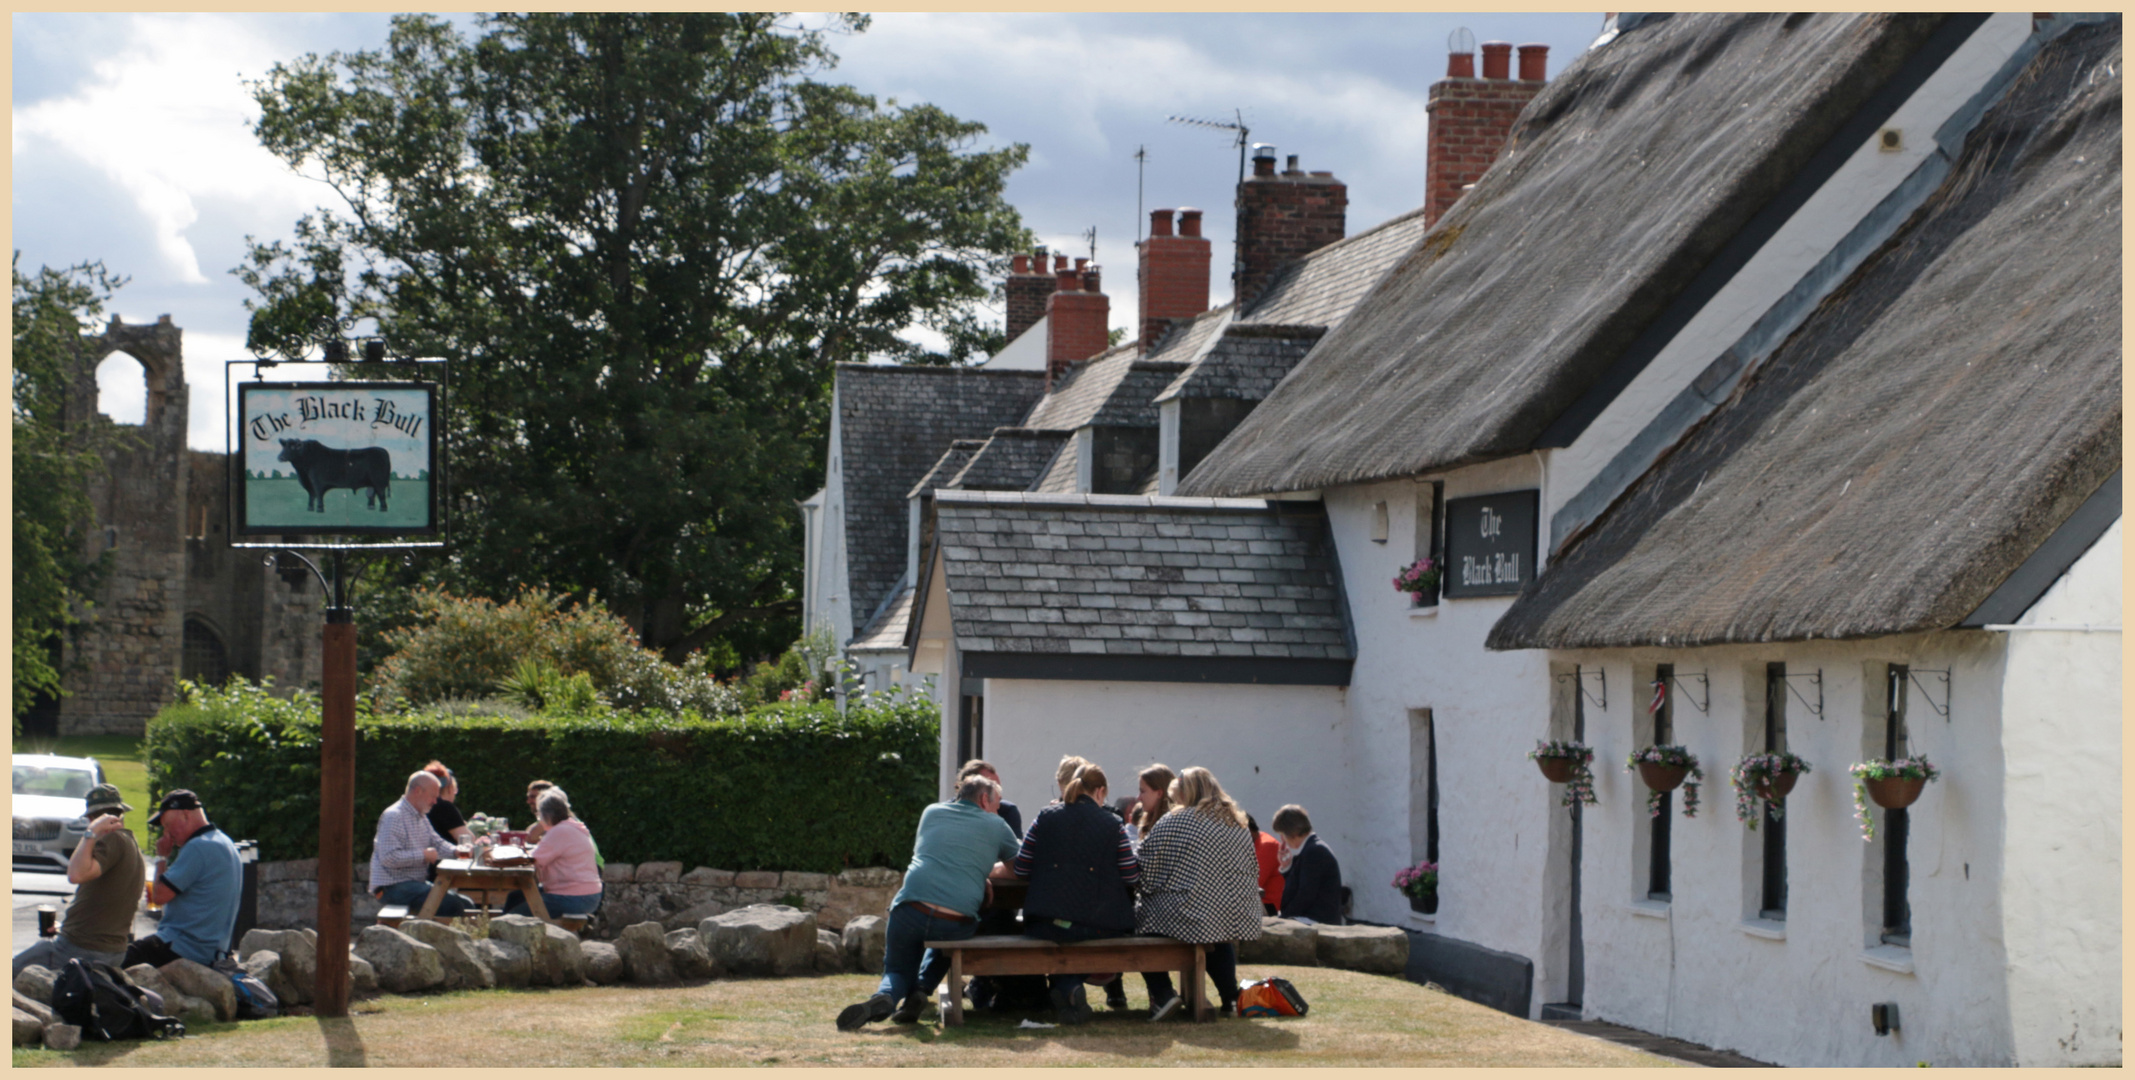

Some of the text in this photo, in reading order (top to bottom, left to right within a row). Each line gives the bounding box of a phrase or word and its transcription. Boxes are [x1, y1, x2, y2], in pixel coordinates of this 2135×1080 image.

[250, 396, 423, 441] The Black Bull
[1481, 506, 1502, 542] The
[1462, 552, 1519, 586] Black Bull
